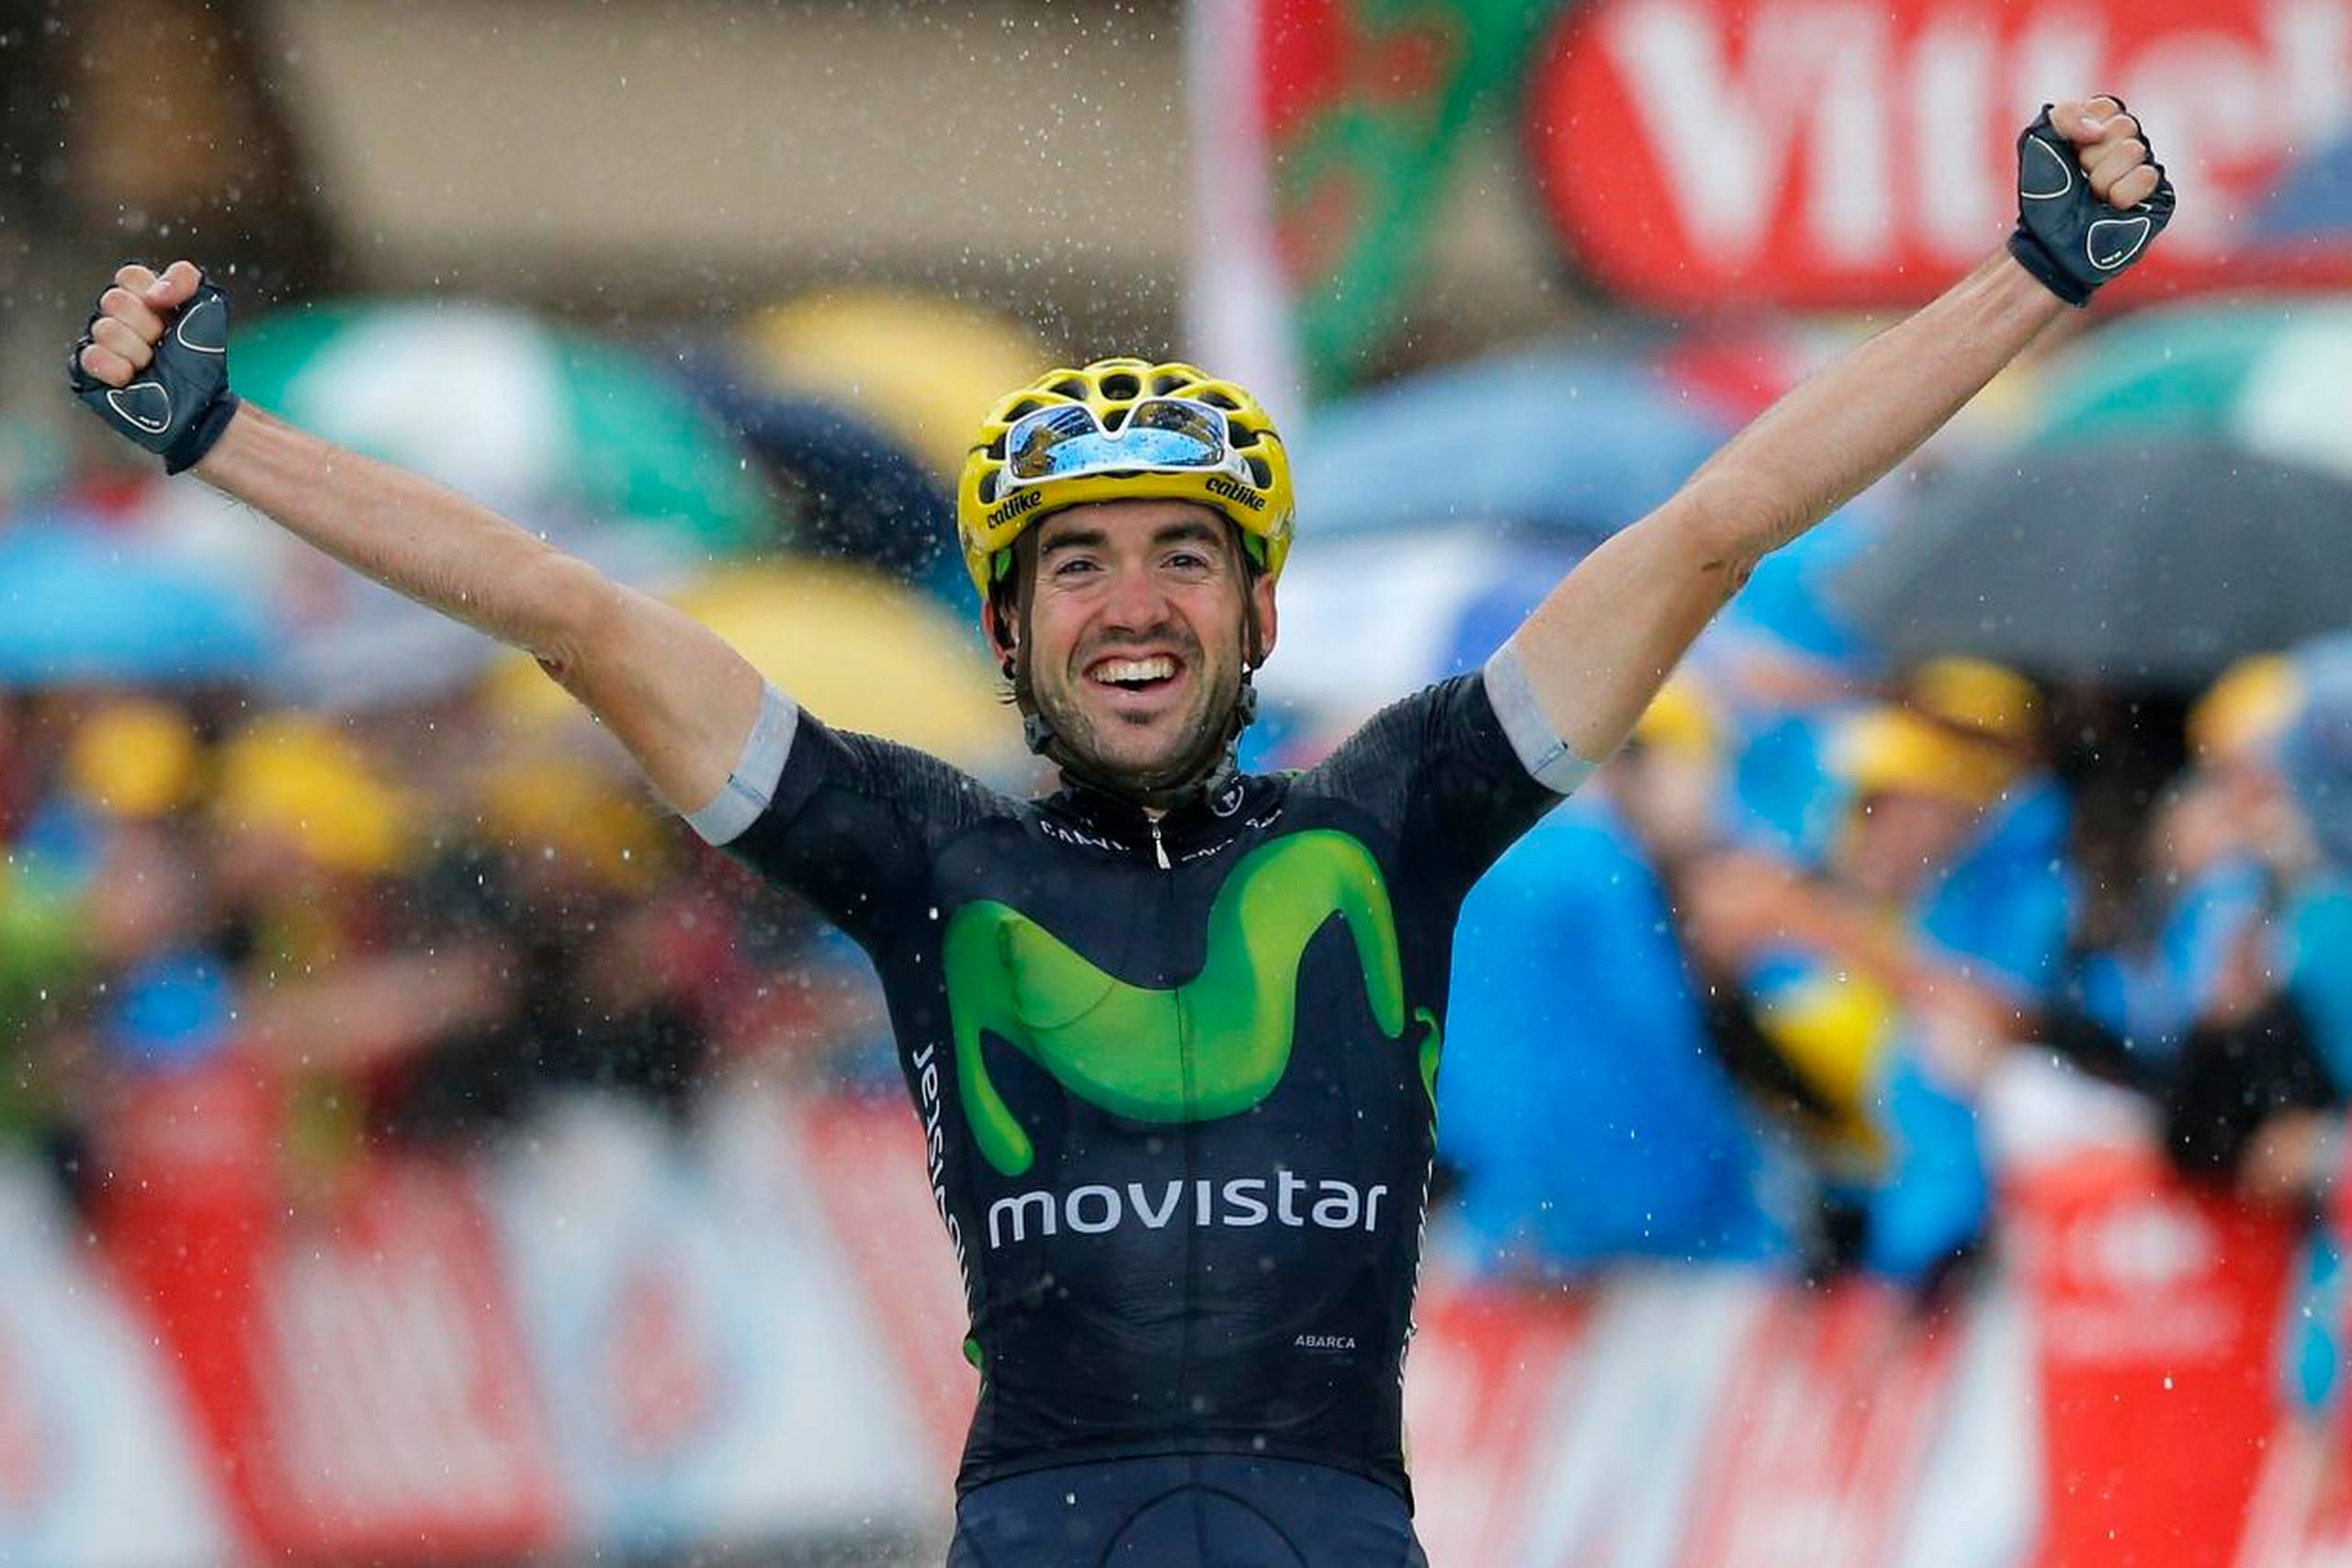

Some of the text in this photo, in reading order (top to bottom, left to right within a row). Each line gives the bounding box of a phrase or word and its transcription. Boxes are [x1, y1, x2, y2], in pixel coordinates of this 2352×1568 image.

[987, 490, 1042, 529] catlike
[1205, 477, 1266, 512] catlike
[989, 1171, 1386, 1249] movistar
[1295, 1335, 1356, 1348] ABARCA
